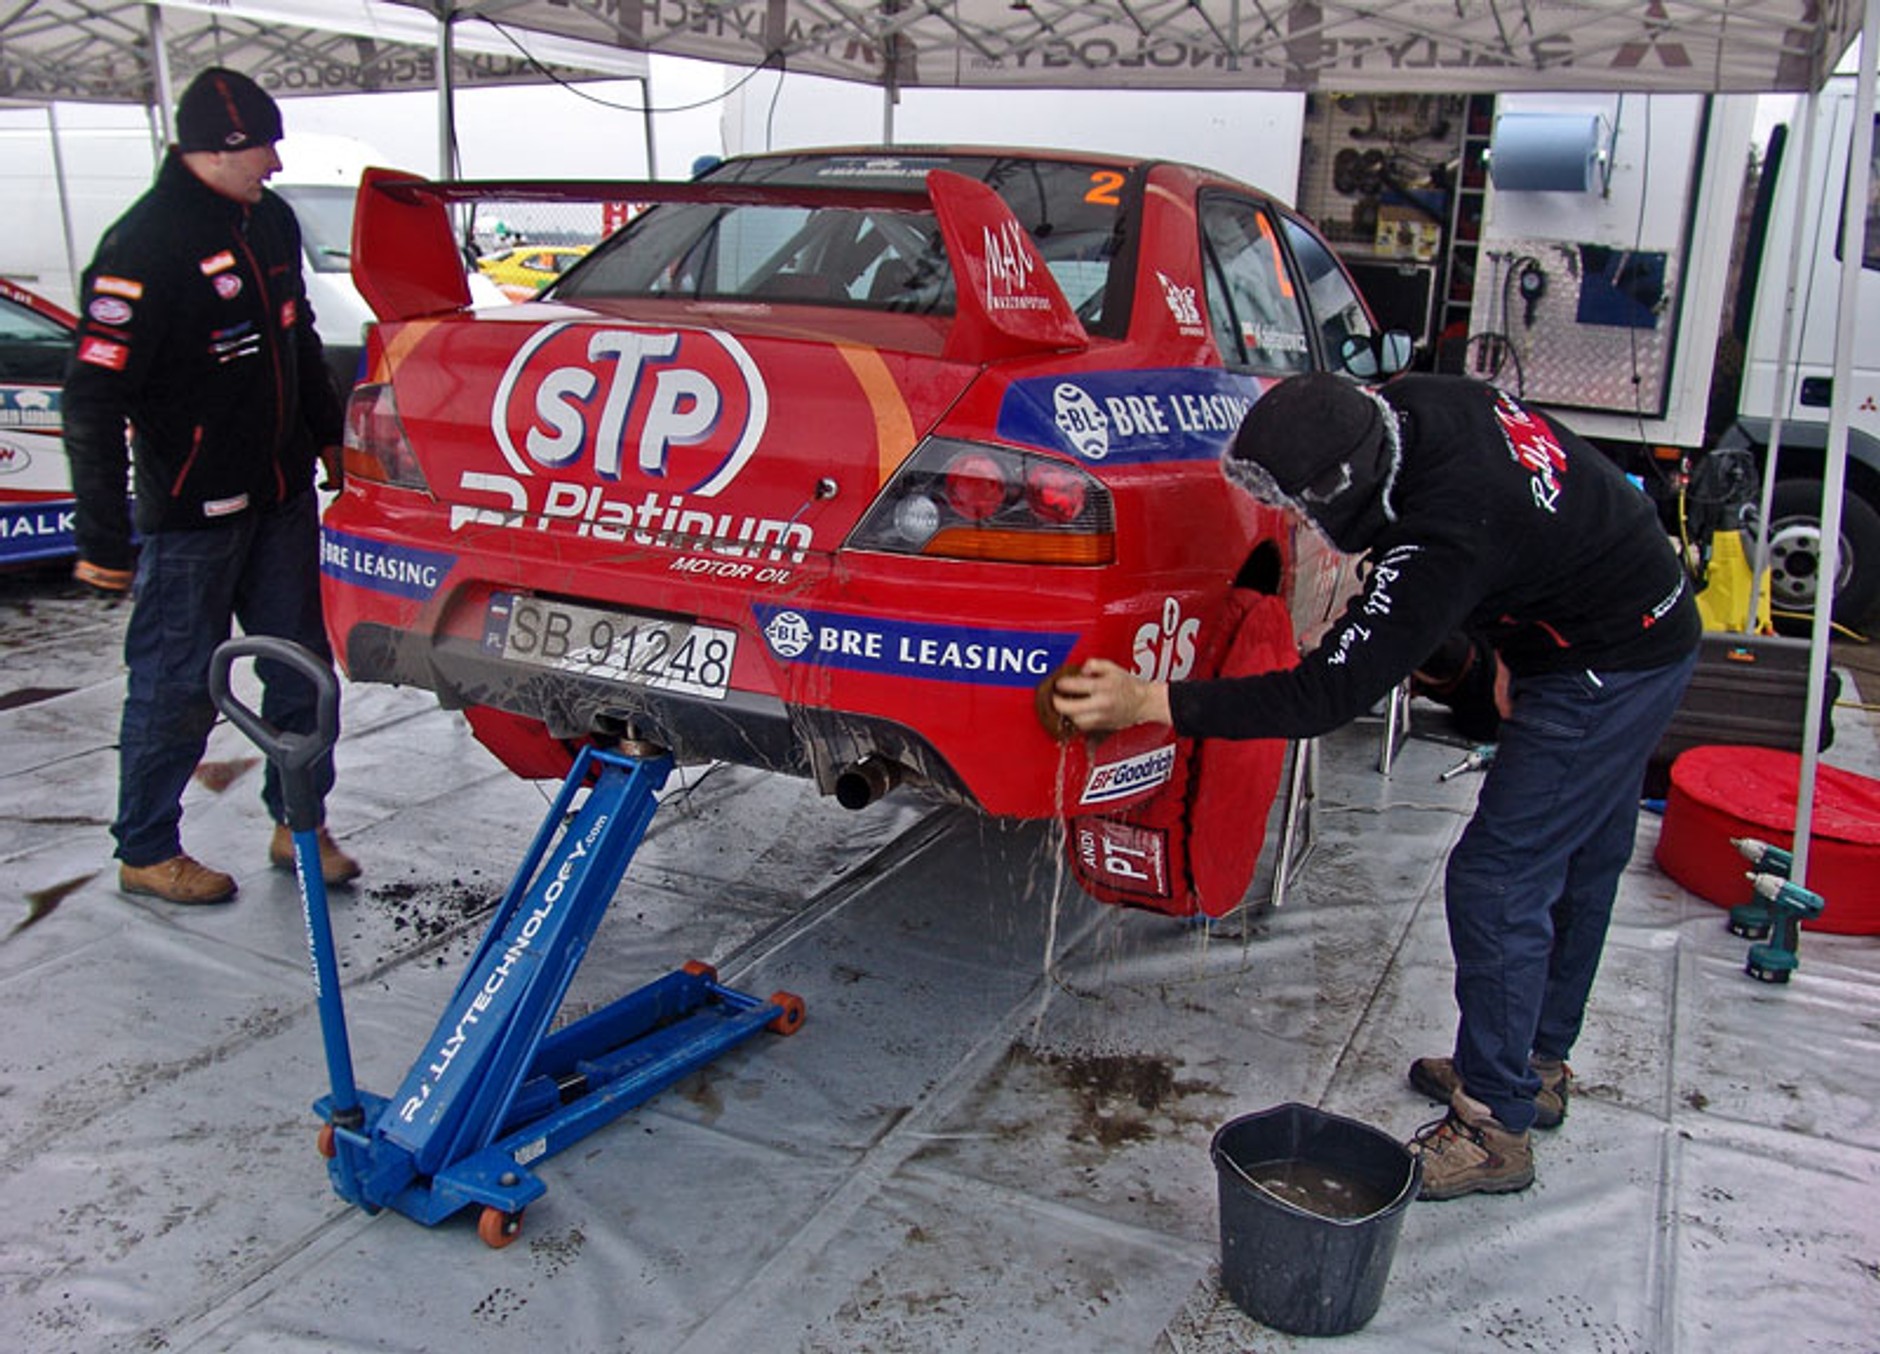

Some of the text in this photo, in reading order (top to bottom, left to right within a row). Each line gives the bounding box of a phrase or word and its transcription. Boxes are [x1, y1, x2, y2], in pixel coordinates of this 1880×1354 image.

[1084, 170, 1126, 206] 2
[525, 329, 724, 482] STP
[1067, 406, 1099, 434] BL
[1104, 395, 1170, 437] BRE
[537, 480, 815, 564] Platinum
[354, 550, 437, 588] LEASING
[669, 556, 793, 585] MOTOR OIL
[510, 605, 730, 688] SB 91248
[777, 625, 1050, 675] BL BRE LEASING
[1089, 750, 1173, 791] BFGoodrich
